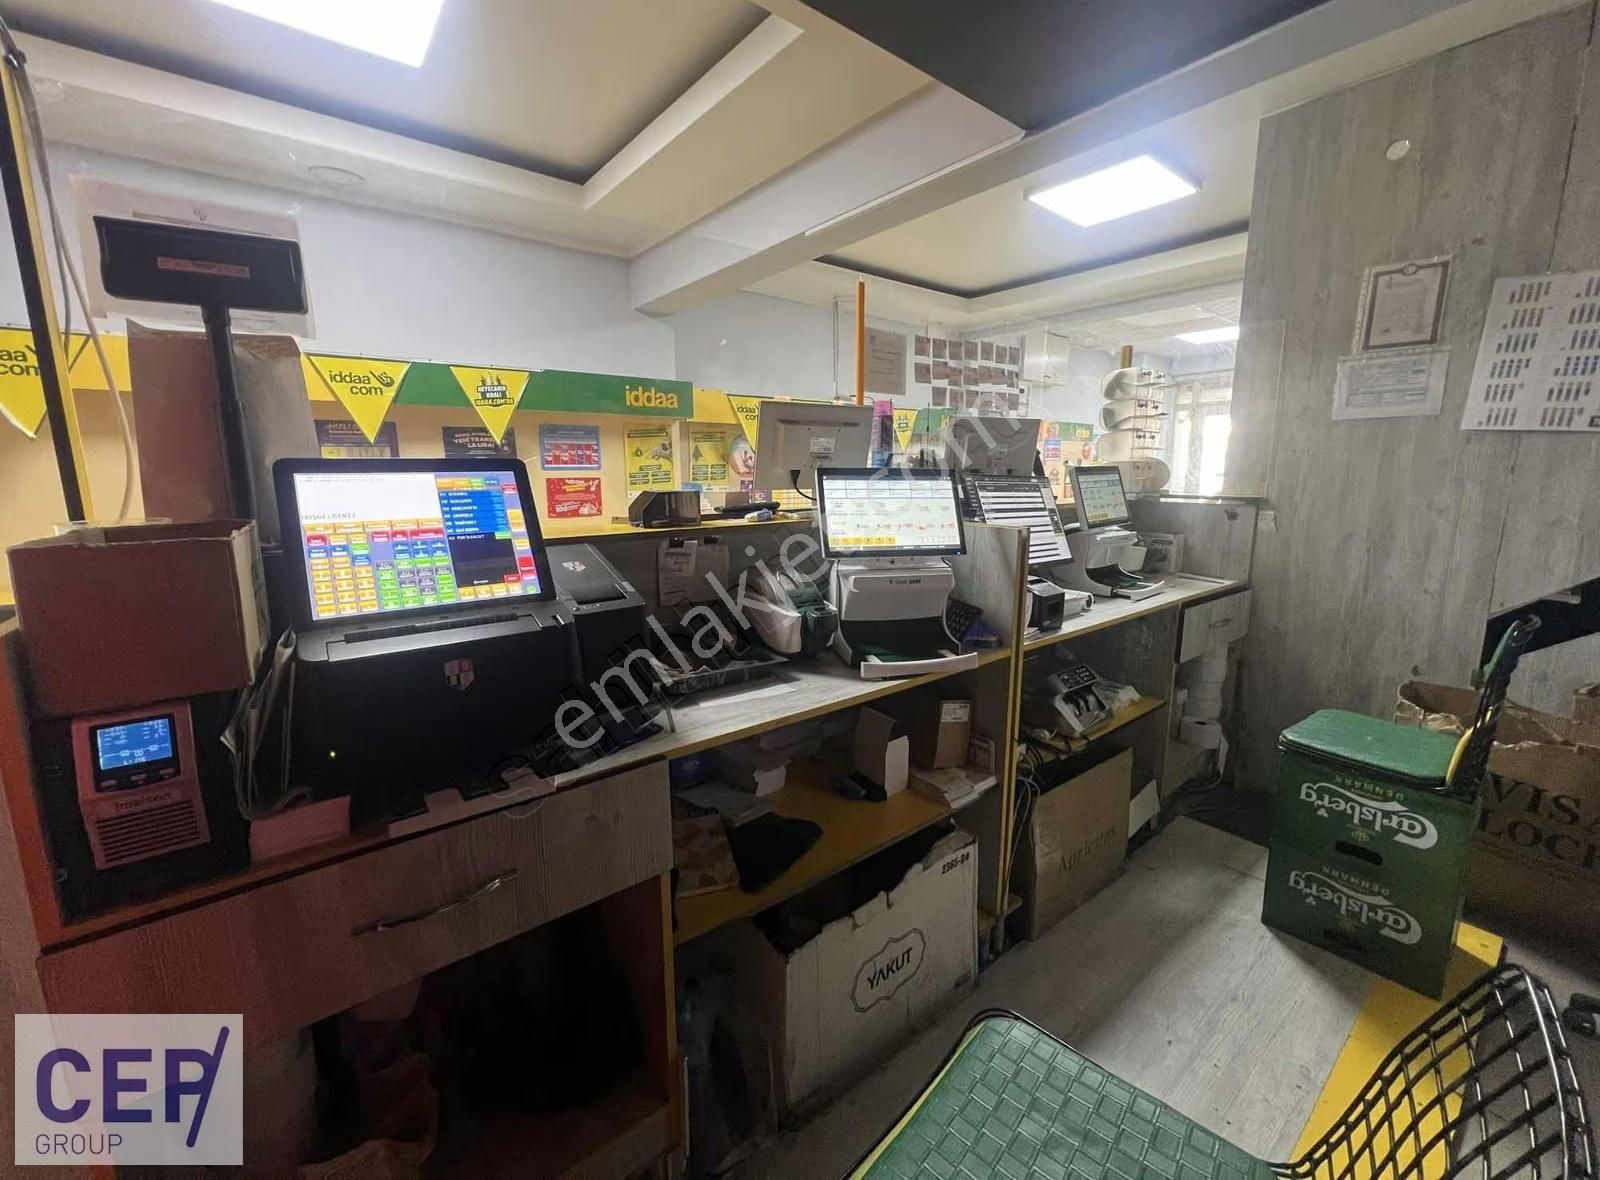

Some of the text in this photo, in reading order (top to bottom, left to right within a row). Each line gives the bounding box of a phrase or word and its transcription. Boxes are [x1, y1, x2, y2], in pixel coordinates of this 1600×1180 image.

[328, 370, 371, 384] iddaa
[350, 385, 383, 396] com
[624, 384, 678, 409] iddaa
[1299, 782, 1439, 850] Carlsberg
[1288, 869, 1422, 945] Carlsberg
[867, 946, 913, 990] YAKUT
